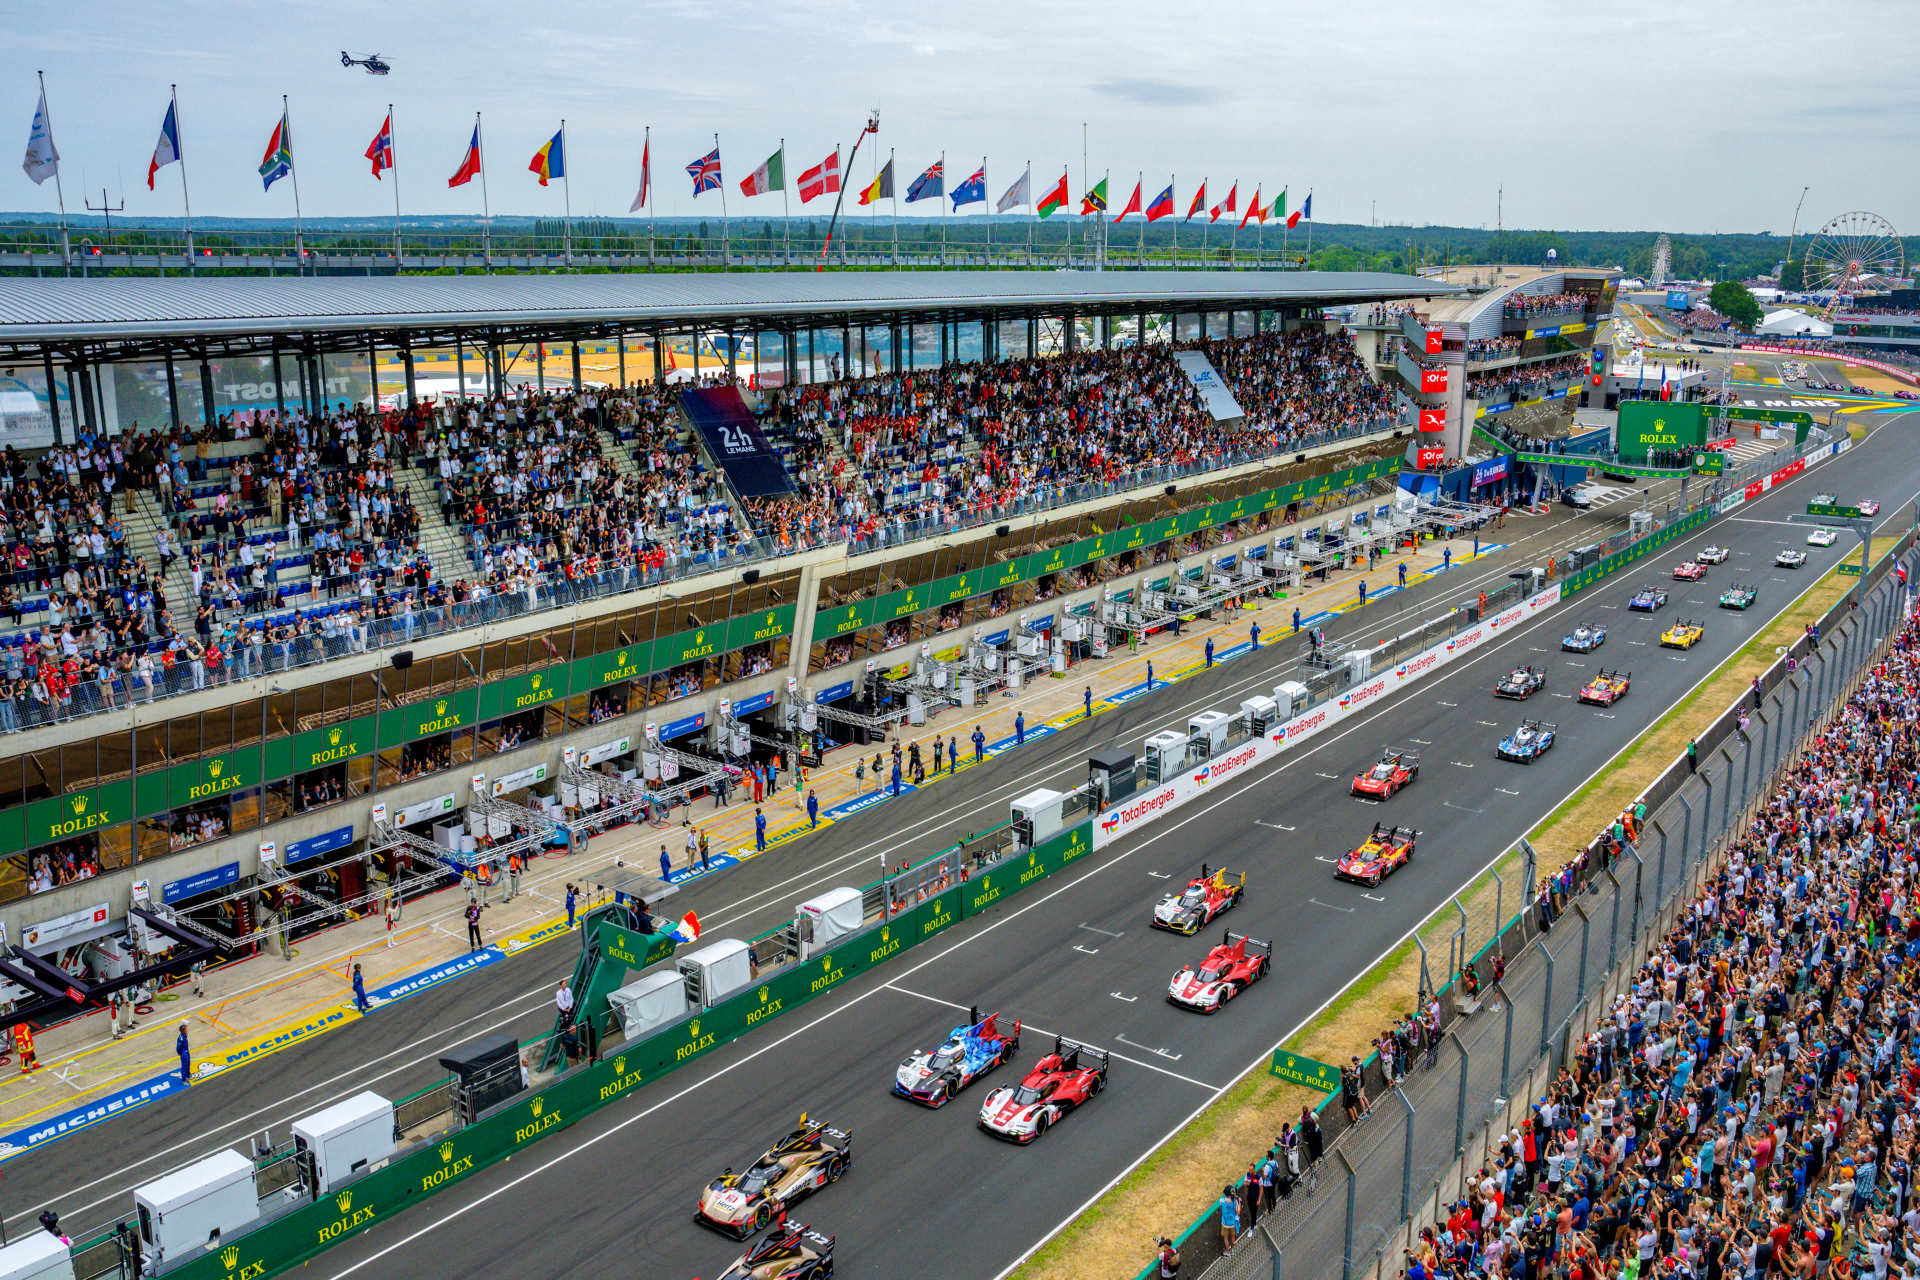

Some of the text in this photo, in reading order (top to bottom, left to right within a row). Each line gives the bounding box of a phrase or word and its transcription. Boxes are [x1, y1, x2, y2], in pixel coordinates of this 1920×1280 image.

[717, 425, 753, 448] 24h
[1640, 434, 1677, 444] ROLEX
[999, 573, 1019, 586] ROLEX
[950, 587, 971, 600] ROLEX
[896, 600, 920, 616] ROLEX
[754, 624, 783, 640] ROLEX
[837, 618, 863, 633] ROLEX
[1456, 630, 1482, 649] TotalEnergies
[683, 644, 713, 661] ROLEX
[1407, 653, 1436, 674] TotalEnergies
[604, 665, 638, 682] ROLEX
[516, 688, 554, 707] ROLEX
[1351, 680, 1385, 705] TotalEnergies
[419, 714, 461, 735] ROLEX
[1286, 711, 1326, 739] TotalEnergies
[311, 743, 358, 765] ROLEX
[1210, 747, 1256, 778] TotalEnergies
[190, 774, 241, 799] ROLEX
[1121, 789, 1175, 824] TotalEnergies
[50, 811, 110, 837] ROLEX
[1063, 842, 1086, 862] ROLEX
[1020, 864, 1044, 884] ROLEX
[974, 887, 1000, 908] ROLEX
[924, 912, 951, 934] ROLEX
[608, 946, 635, 964] ROLEX
[871, 939, 900, 962] ROLEX
[389, 952, 491, 998] MICHELIN
[811, 968, 844, 992] ROLEX
[746, 999, 782, 1025] ROLEX
[226, 1012, 344, 1063] MICHELIN
[676, 1032, 715, 1061] ROLEX
[600, 1070, 643, 1100] ROLEX
[1275, 1066, 1335, 1091] ROLEX ROLEX
[28, 1080, 170, 1144] MICHELIN
[515, 1110, 563, 1144] ROLEX
[421, 1155, 474, 1192] ROLEX
[791, 1178, 811, 1194] Hertz
[717, 1200, 736, 1212] Hertz
[317, 1204, 375, 1244] ROLEX
